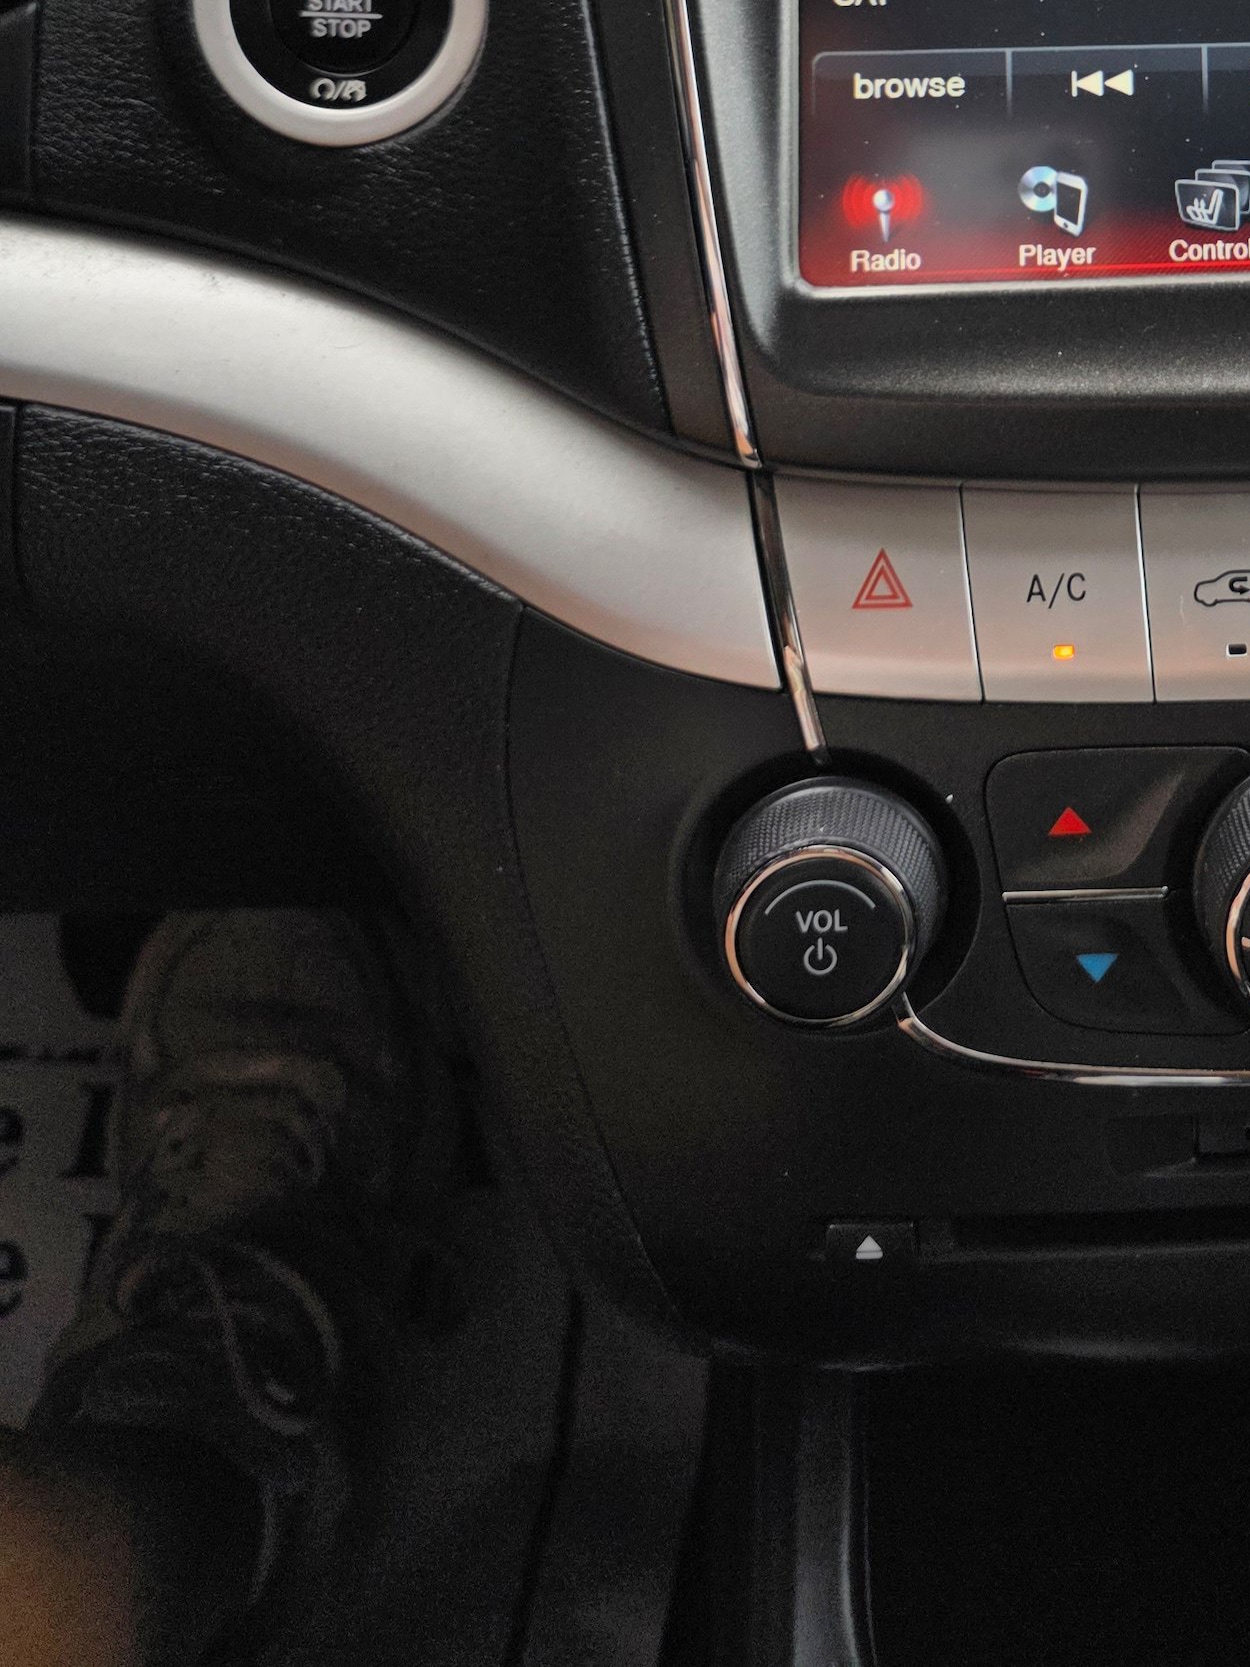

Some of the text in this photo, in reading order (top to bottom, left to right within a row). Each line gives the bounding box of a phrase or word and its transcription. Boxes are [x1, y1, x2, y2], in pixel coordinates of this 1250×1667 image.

[312, 19, 372, 38] STOP
[854, 73, 965, 99] browse
[852, 249, 921, 271] Radio
[1019, 244, 1096, 271] Player
[1027, 573, 1086, 609] A/C
[796, 909, 848, 933] VOL
